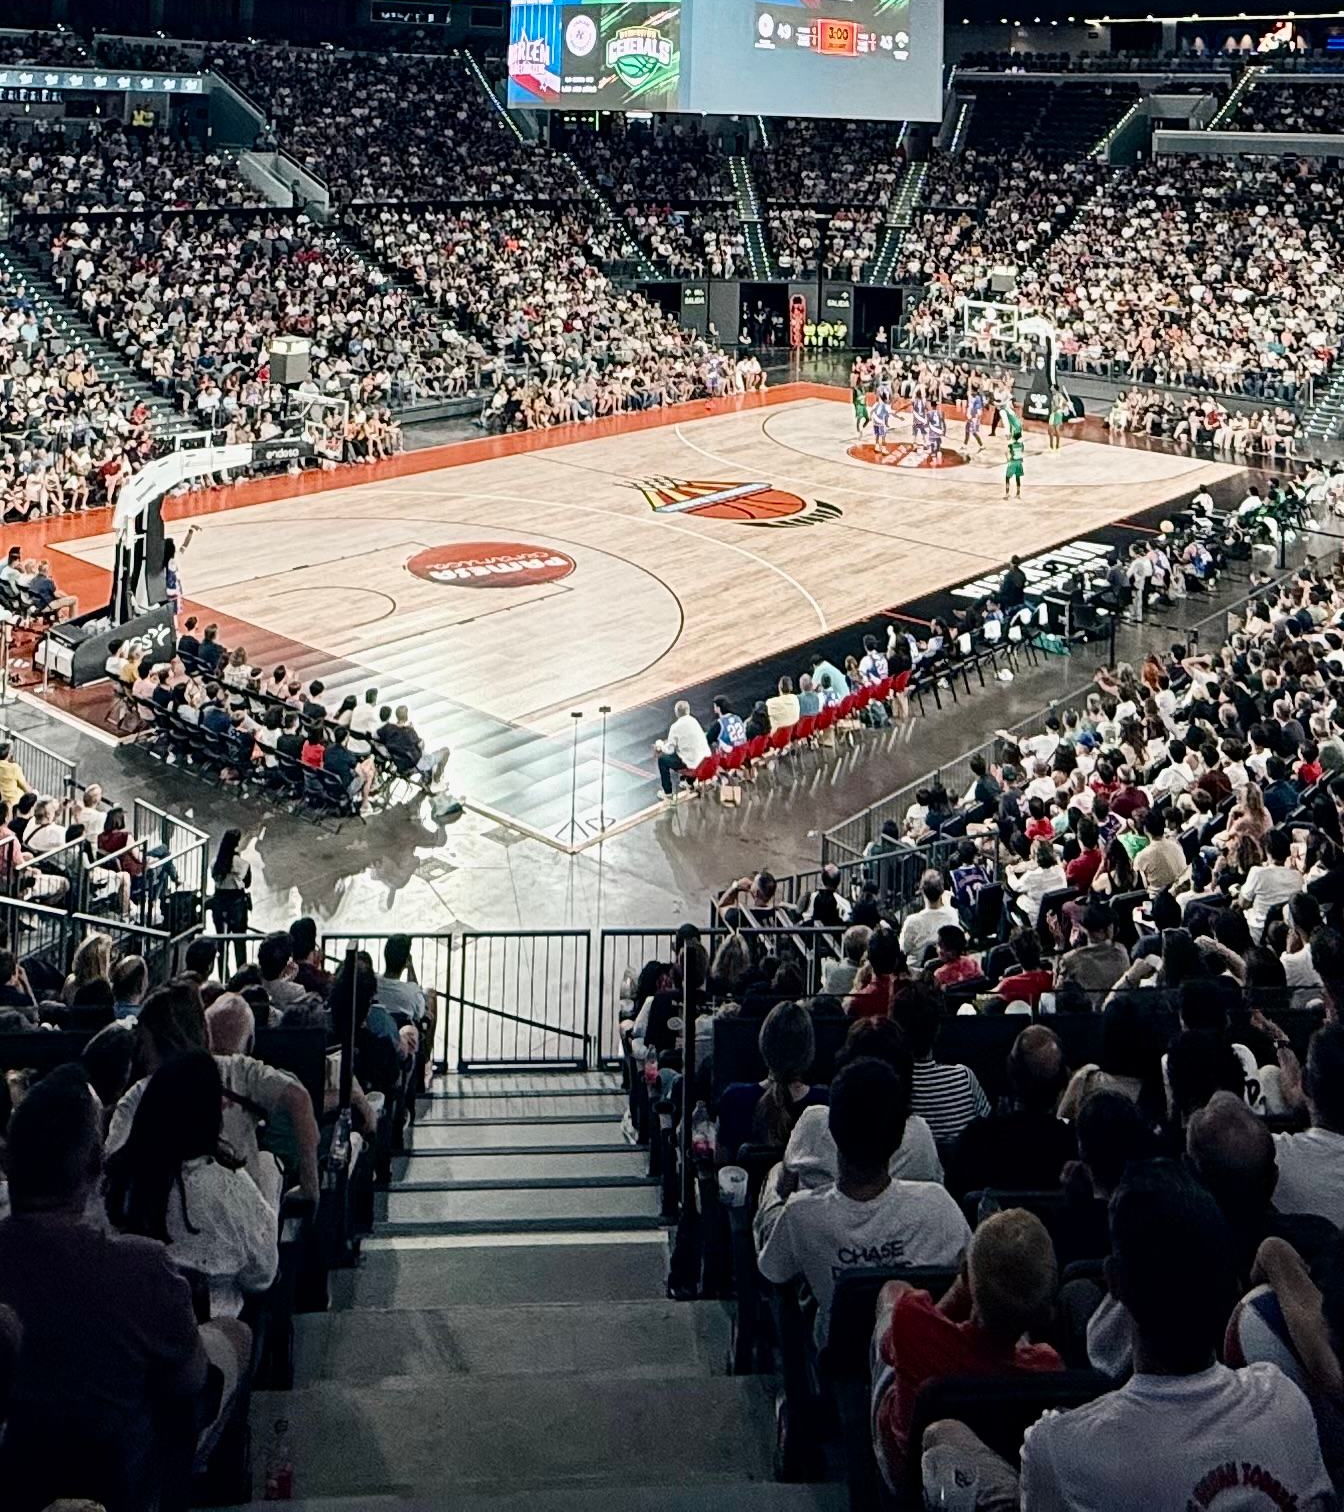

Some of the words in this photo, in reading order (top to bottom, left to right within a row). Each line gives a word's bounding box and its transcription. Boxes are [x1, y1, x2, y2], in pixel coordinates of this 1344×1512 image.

[429, 556, 568, 581] PAMESA
[726, 721, 743, 742] 22
[837, 1239, 904, 1264] CHASE
